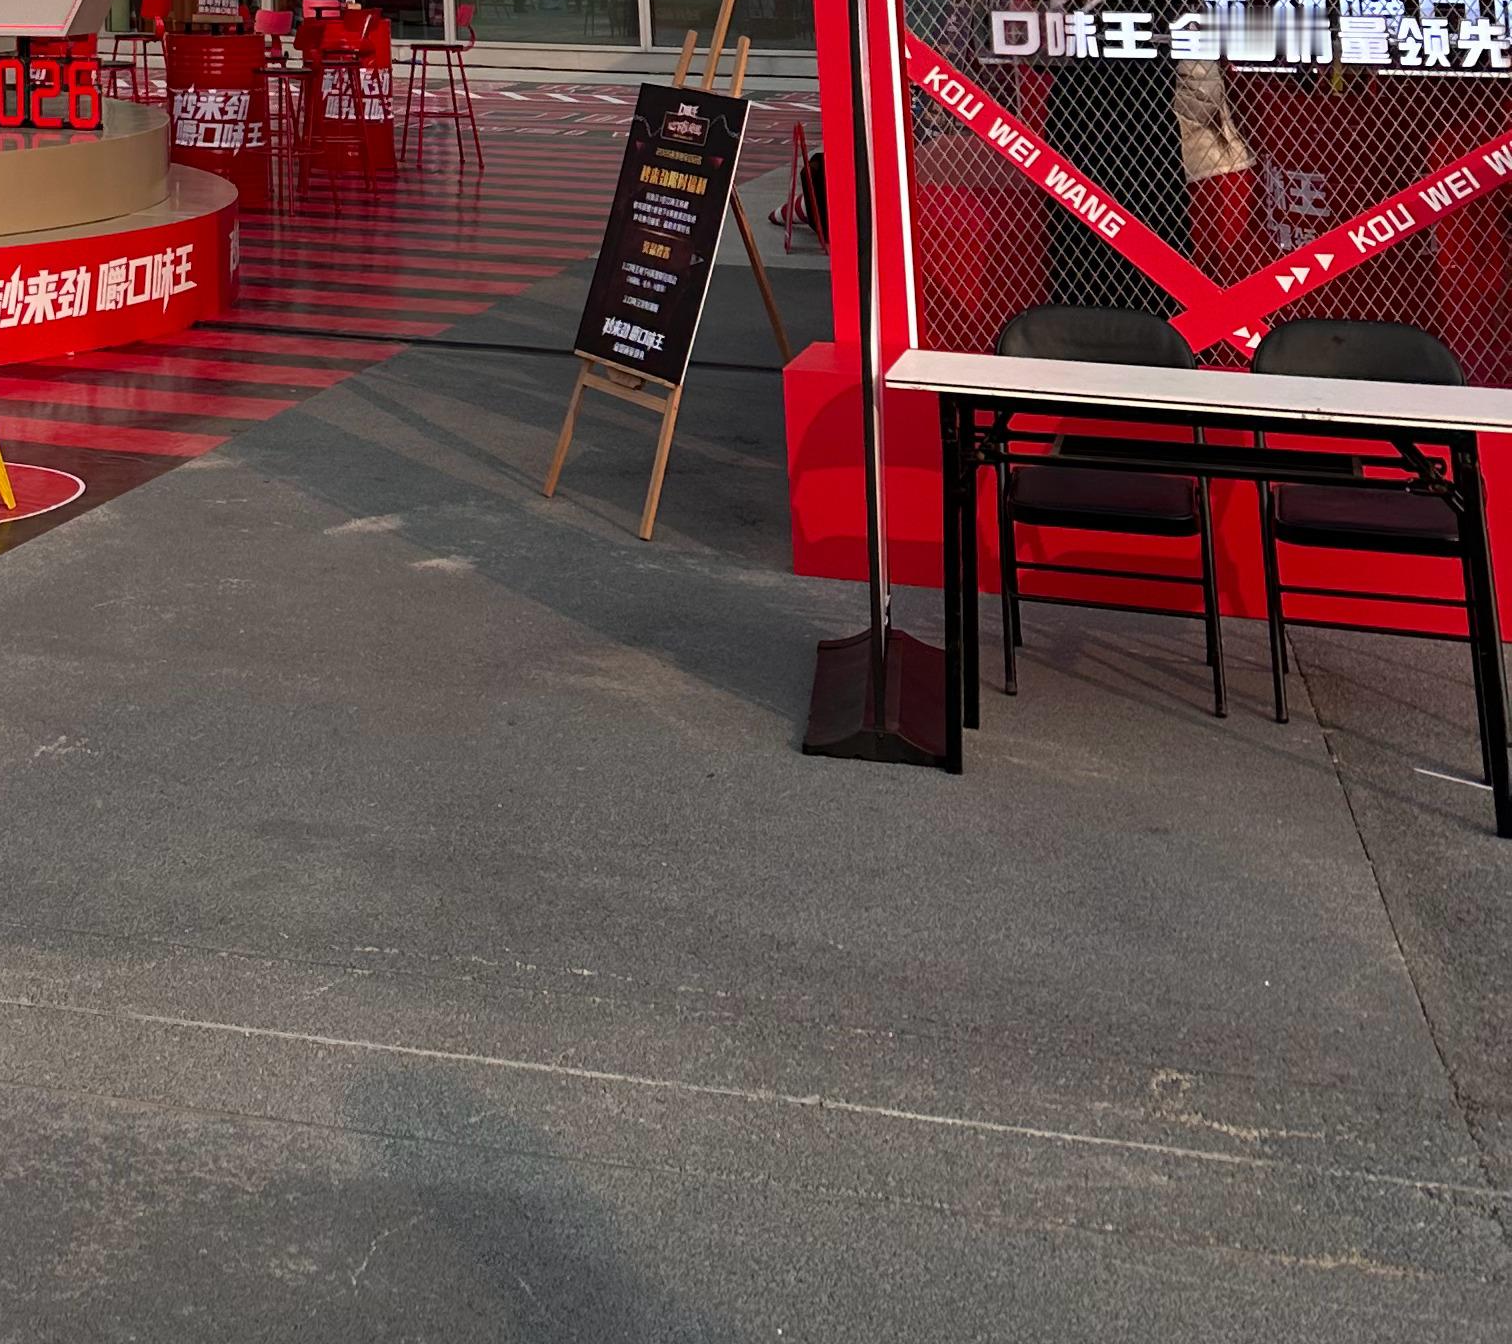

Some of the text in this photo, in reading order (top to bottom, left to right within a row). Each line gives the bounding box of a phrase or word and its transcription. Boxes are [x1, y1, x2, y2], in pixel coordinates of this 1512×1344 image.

[923, 65, 1127, 240] KOU WEI WANG
[1347, 202, 1416, 254] KOU
[1418, 166, 1481, 213] WEI
[95, 243, 197, 315] 嚼口味王
